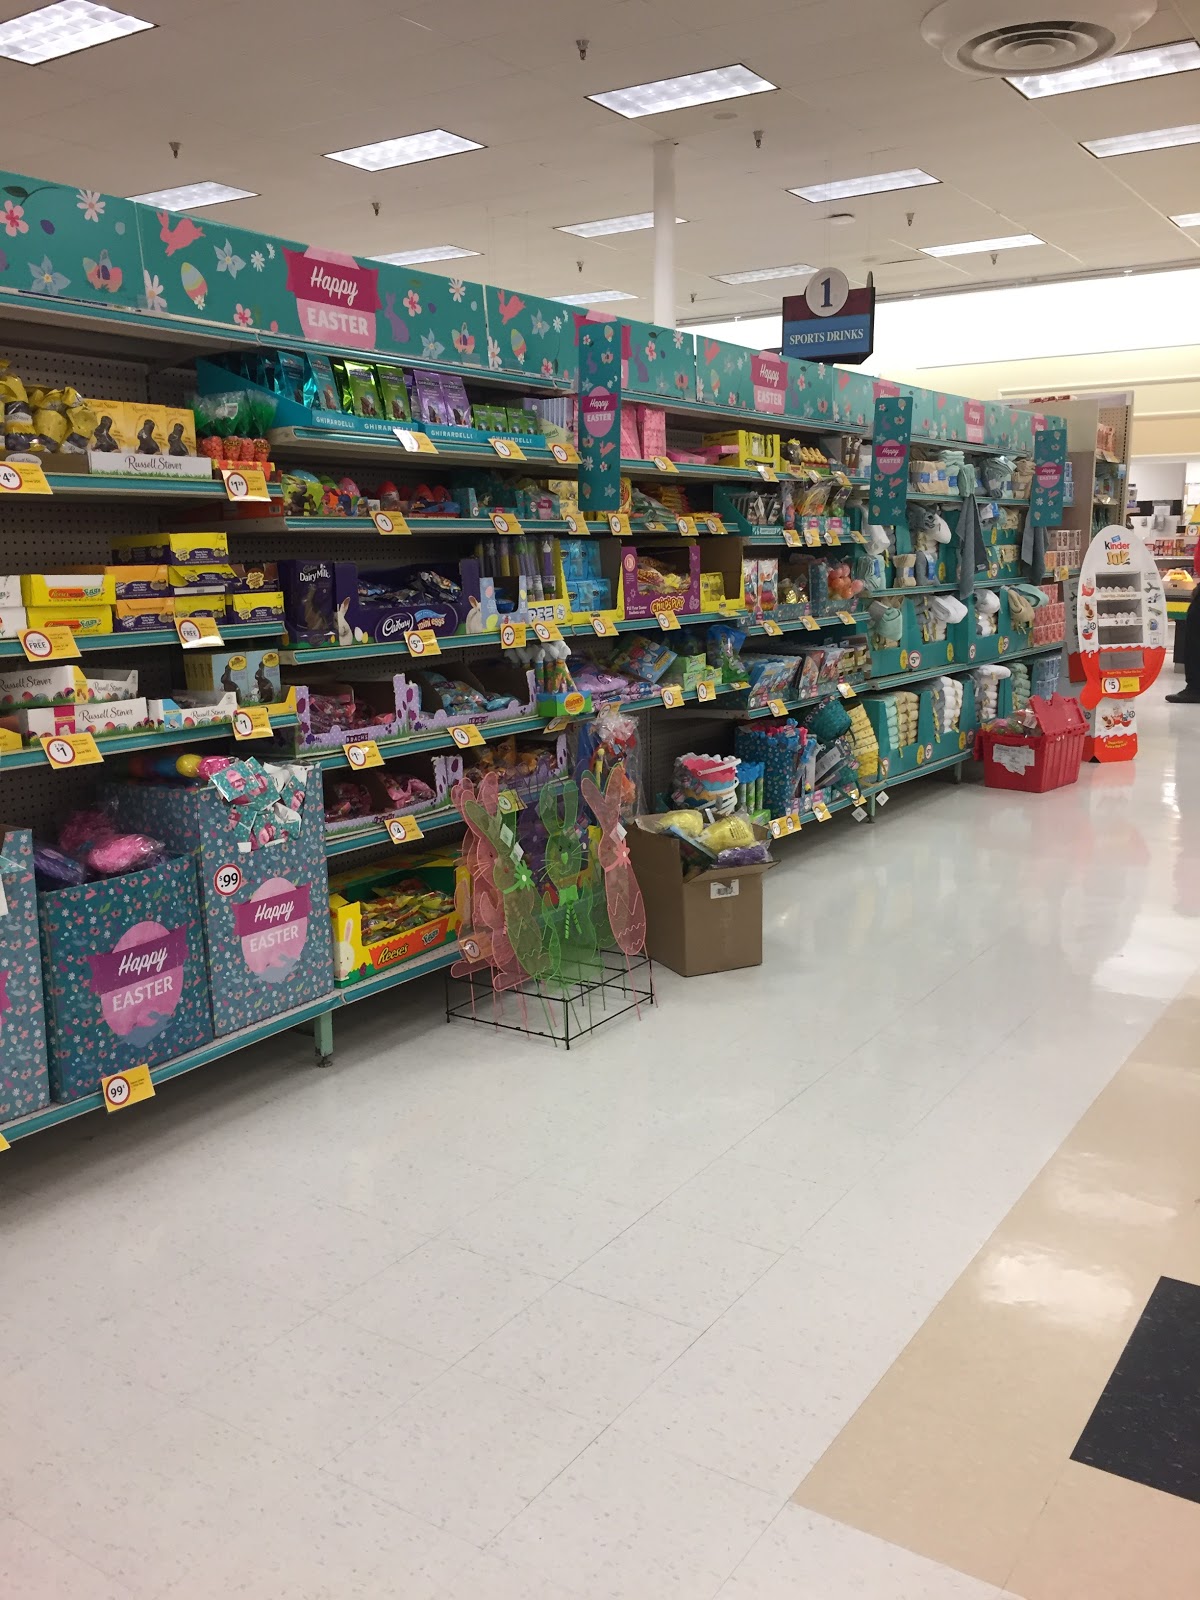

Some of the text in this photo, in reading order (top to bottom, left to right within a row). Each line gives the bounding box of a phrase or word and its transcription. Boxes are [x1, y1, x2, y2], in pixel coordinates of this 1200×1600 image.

[310, 266, 358, 306] Happy
[820, 277, 833, 308] 1
[307, 308, 369, 336] EASTER
[789, 328, 864, 345] SPORTS DRINKS
[760, 364, 780, 387] Happy
[589, 398, 609, 410] Happy
[757, 390, 783, 406] EASTER
[315, 416, 355, 428] GHIRARDELLI
[587, 413, 612, 423] EASTER
[431, 430, 473, 440] GHIRARDELLI
[881, 447, 900, 458] Happy
[125, 455, 182, 471] Russell Stover
[1104, 541, 1130, 550] Kinder
[300, 567, 331, 582] Dairy Milk
[382, 617, 445, 637] Cadbury mini eggs
[28, 641, 47, 650] FREE
[26, 675, 52, 688] Stover
[79, 707, 133, 723] Russell Stover
[254, 898, 294, 924] Happy
[250, 924, 299, 953] EASTER
[118, 946, 168, 977] Happy
[111, 977, 173, 1013] EASTER
